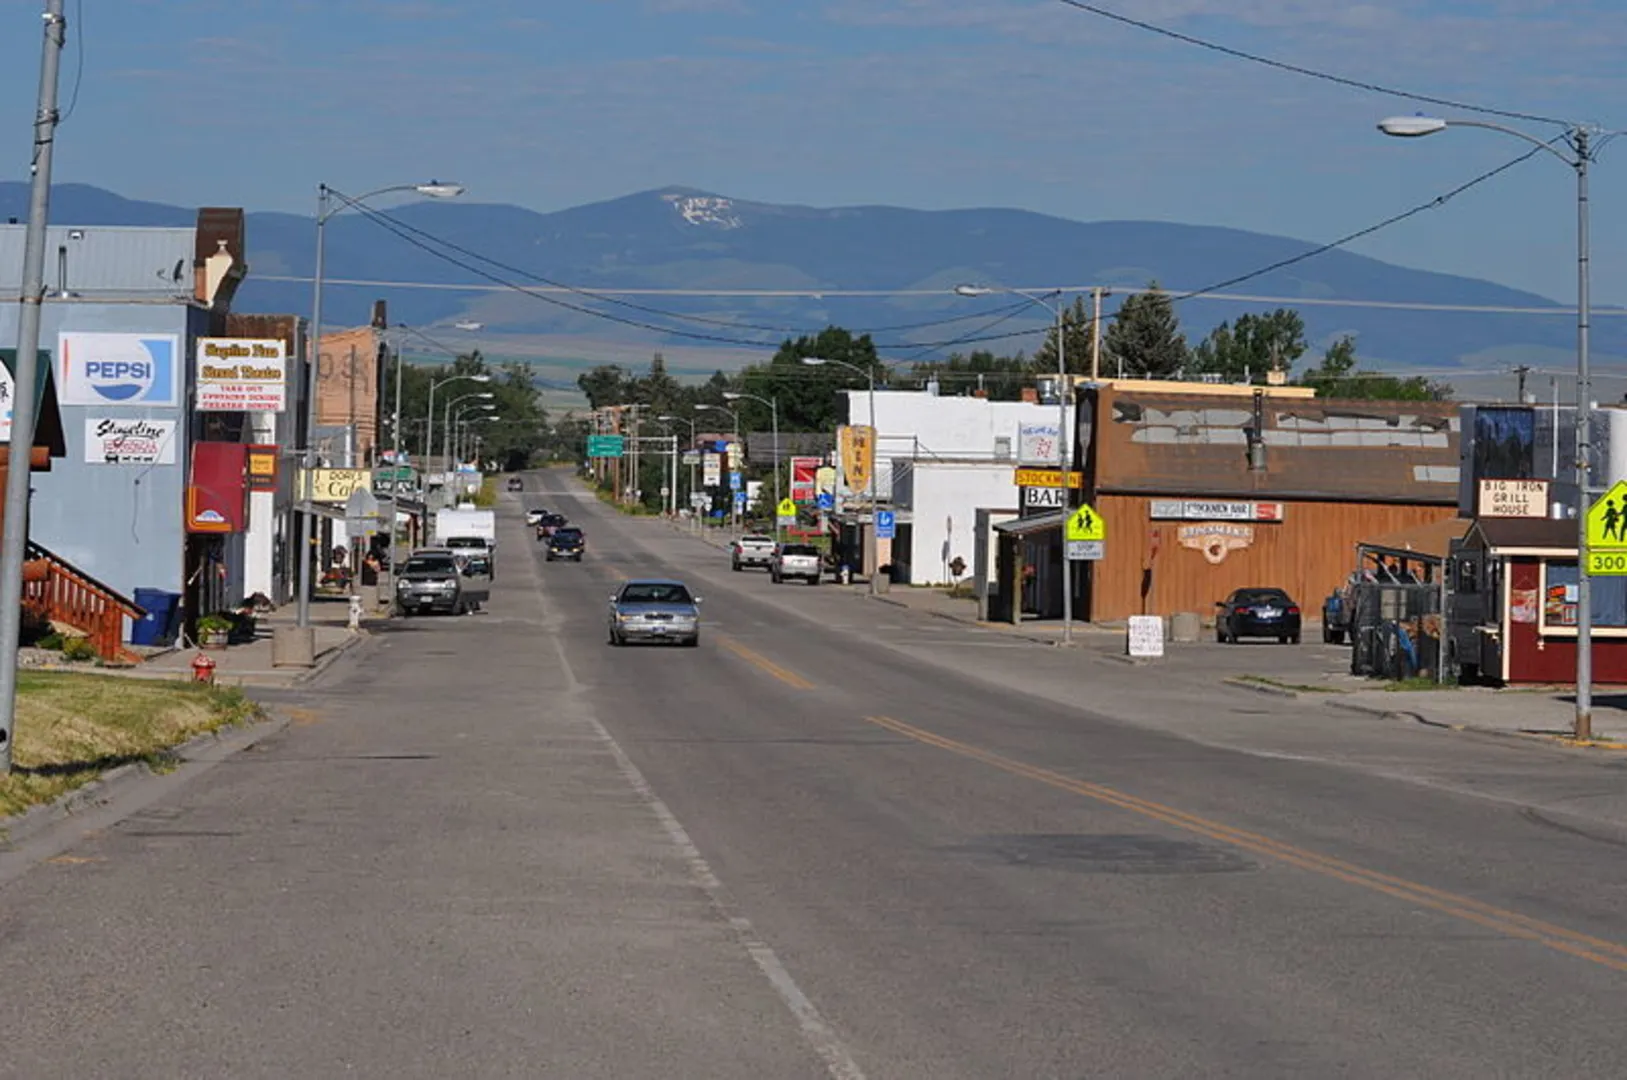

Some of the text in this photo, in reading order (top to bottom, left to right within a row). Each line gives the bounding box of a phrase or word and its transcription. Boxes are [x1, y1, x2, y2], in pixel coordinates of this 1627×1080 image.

[86, 362, 150, 379] PEPSI
[1019, 471, 1077, 485] STOCKMN
[1485, 481, 1543, 492] BIG IRON
[1028, 488, 1063, 505] BAR
[1493, 492, 1529, 503] GRILL
[1493, 504, 1529, 515] HOUSE
[1594, 556, 1625, 570] 300
